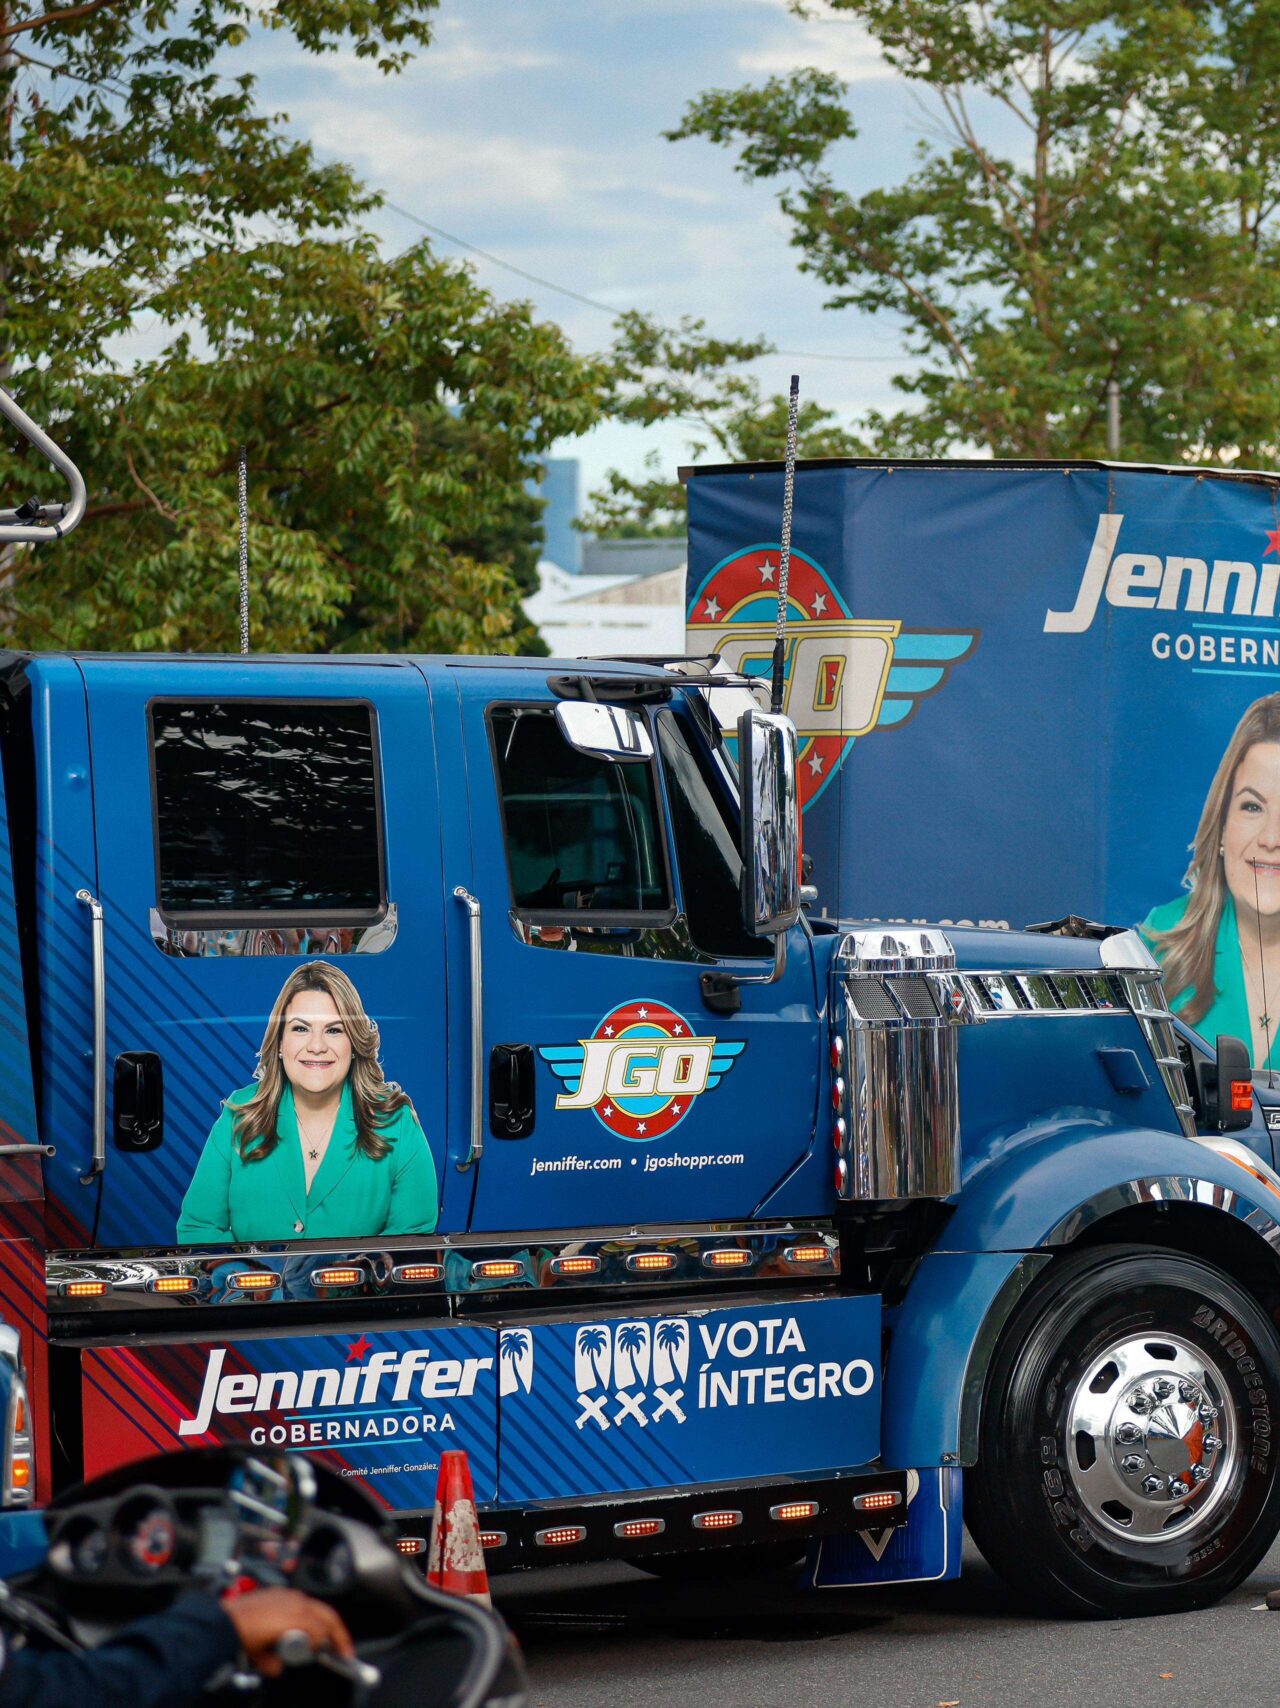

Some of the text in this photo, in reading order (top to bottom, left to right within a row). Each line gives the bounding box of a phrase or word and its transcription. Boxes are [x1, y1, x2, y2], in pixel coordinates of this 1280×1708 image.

[555, 1036, 717, 1110] JGO
[530, 1153, 744, 1176] jenniffer.com jgoshoppr.com
[699, 1317, 806, 1360] VOTA
[178, 1342, 494, 1436] Jenniffer
[698, 1358, 875, 1409] ÍNTEGRO
[1190, 1303, 1272, 1475] BRIDGESTONE
[250, 1413, 456, 1446] GOBERNADORA
[341, 1466, 368, 1477] Comité
[369, 1464, 402, 1475] Jenniffer
